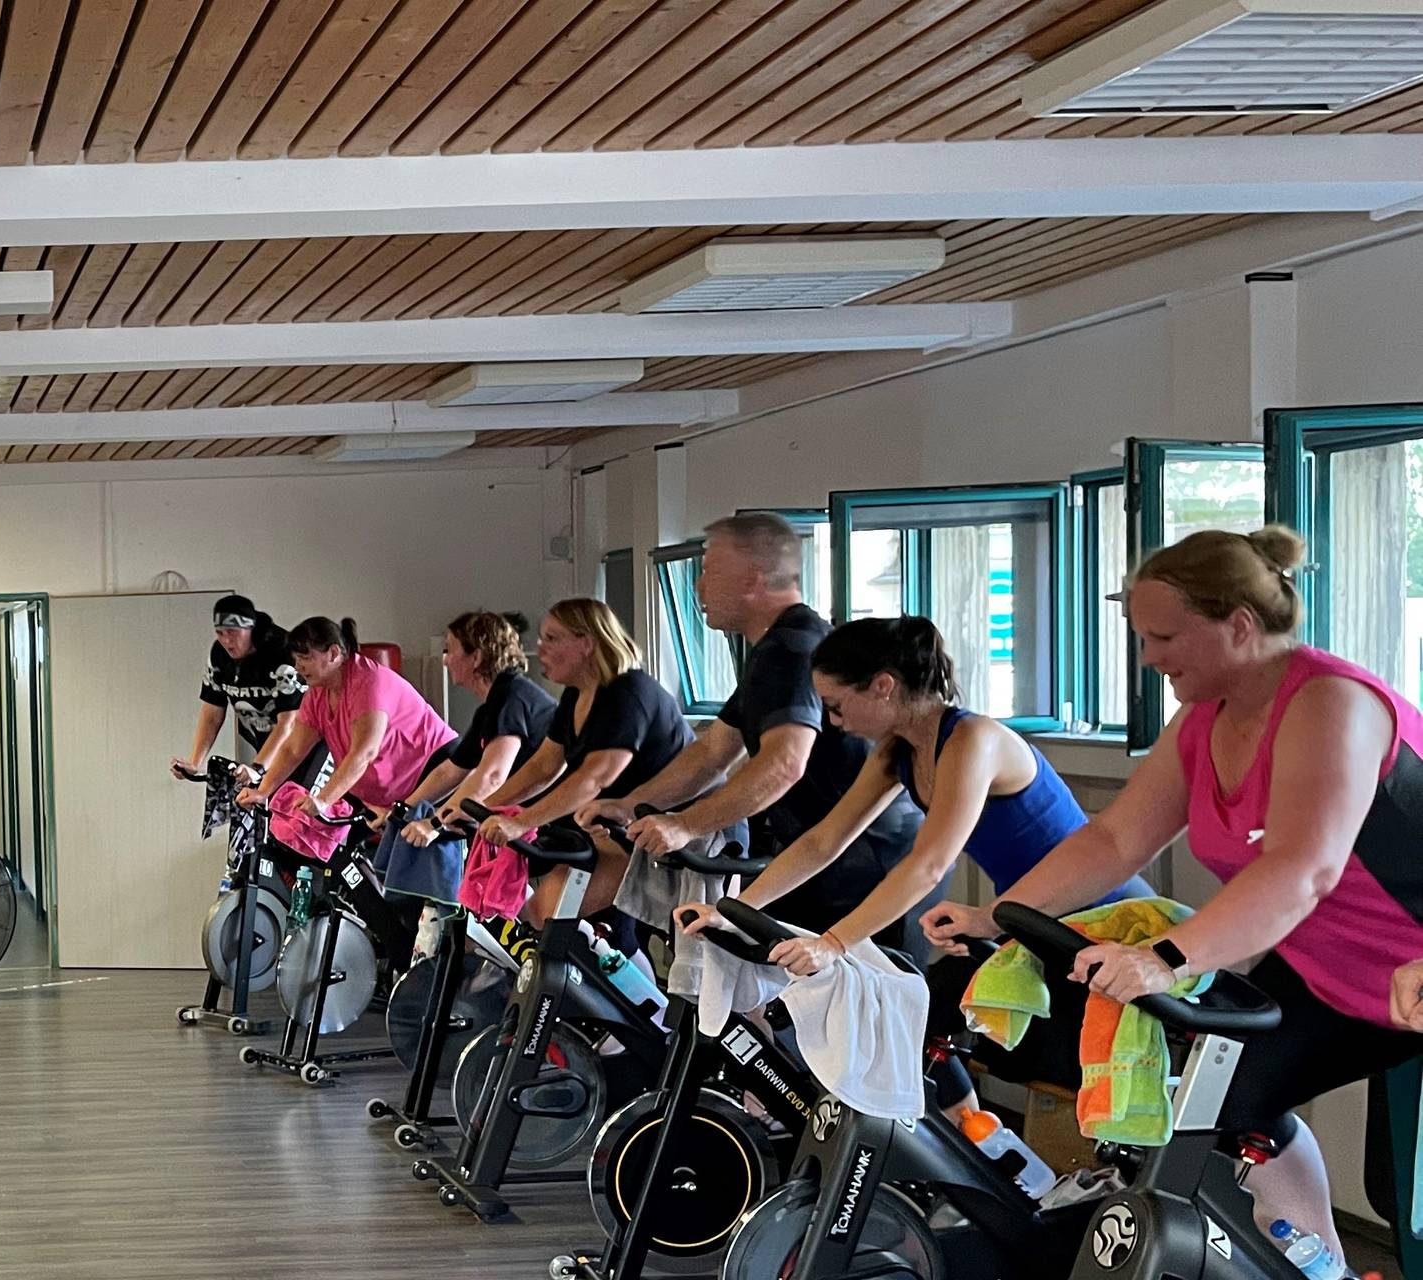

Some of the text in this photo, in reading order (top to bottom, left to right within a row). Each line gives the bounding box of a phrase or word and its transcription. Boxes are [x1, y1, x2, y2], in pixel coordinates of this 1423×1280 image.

[259, 860, 273, 876] 10
[343, 866, 362, 886] 19
[524, 997, 552, 1055] TOMAHAWK
[723, 1028, 758, 1063] 11
[754, 1058, 790, 1094] DARWIN
[785, 1091, 805, 1111] EVO
[830, 1149, 872, 1236] TOMAHAWK
